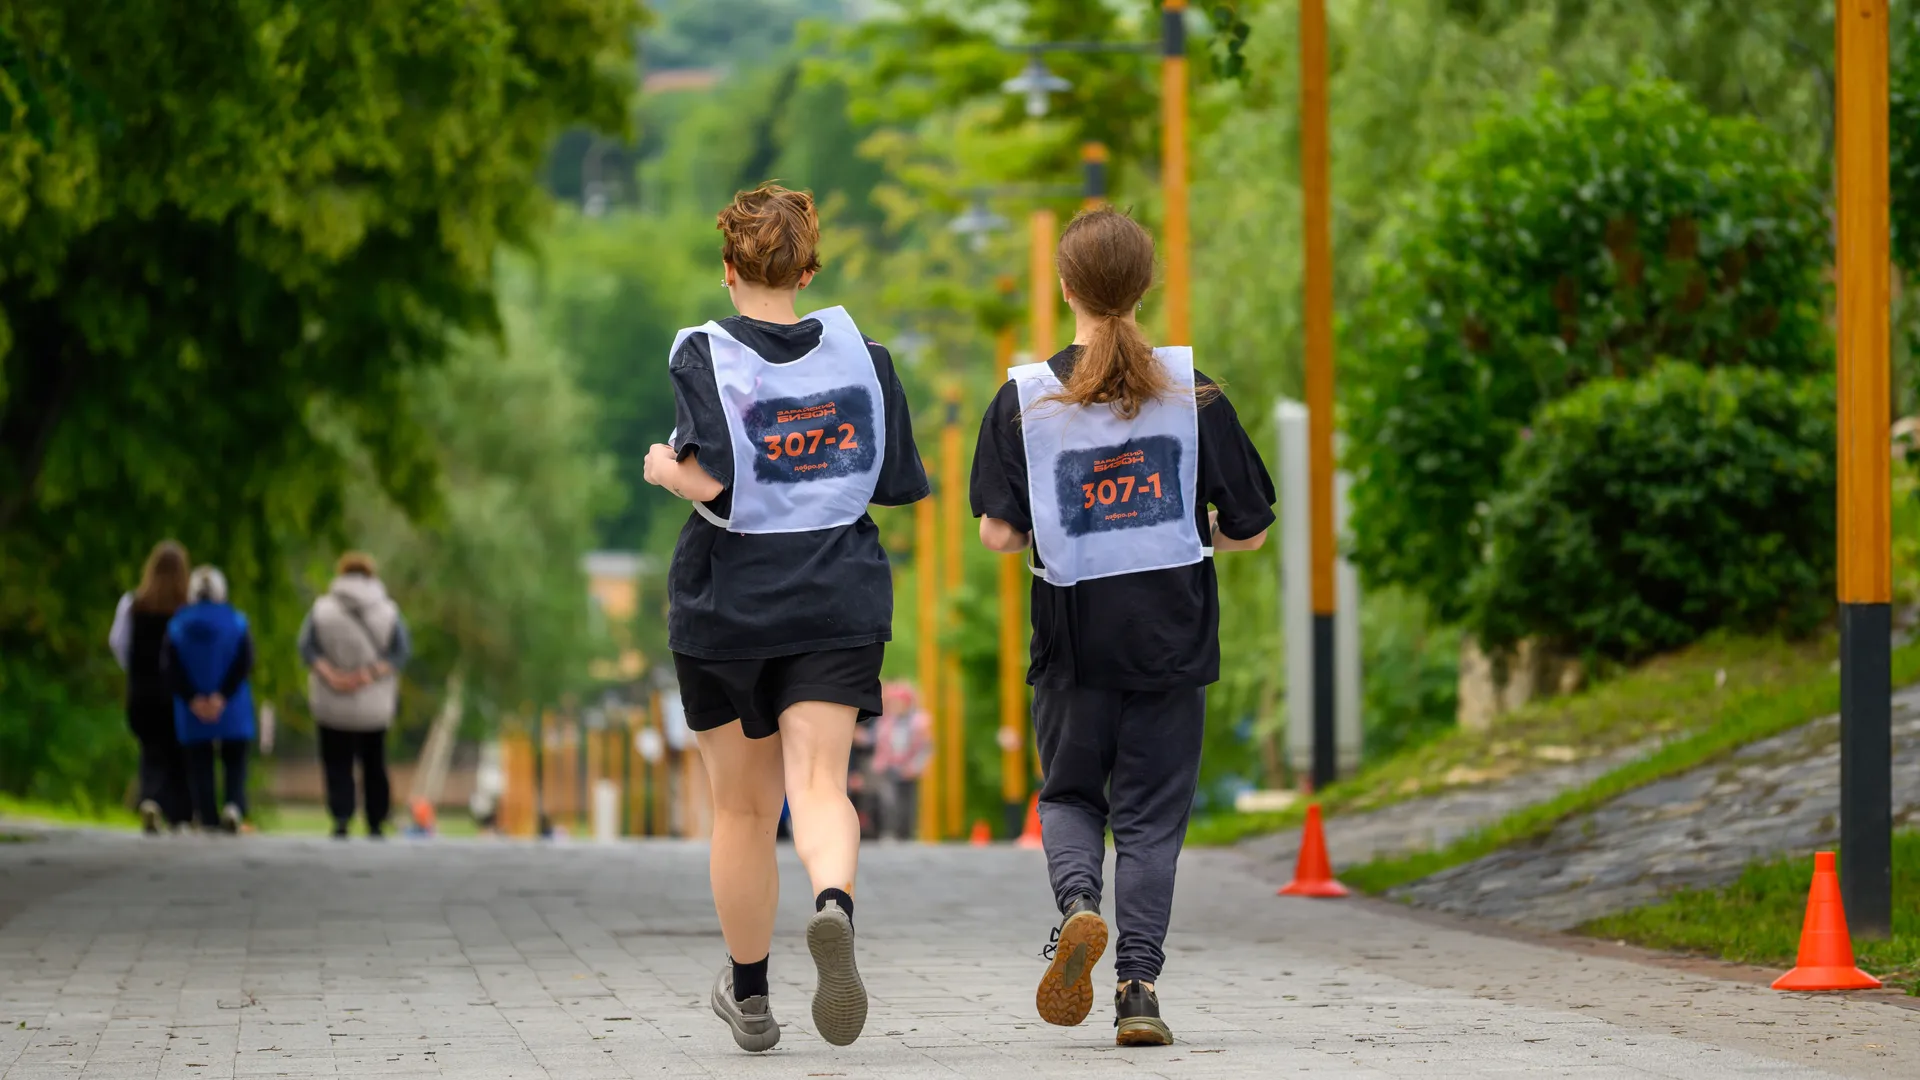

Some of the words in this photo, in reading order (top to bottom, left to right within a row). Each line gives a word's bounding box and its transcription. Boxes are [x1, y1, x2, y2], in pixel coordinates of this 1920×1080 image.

[777, 408, 836, 423] БИЗОН
[764, 423, 858, 461] 307-2
[794, 462, 828, 472] добро.рф
[1094, 456, 1144, 472] БИЗОН
[1082, 472, 1161, 509] 307-1
